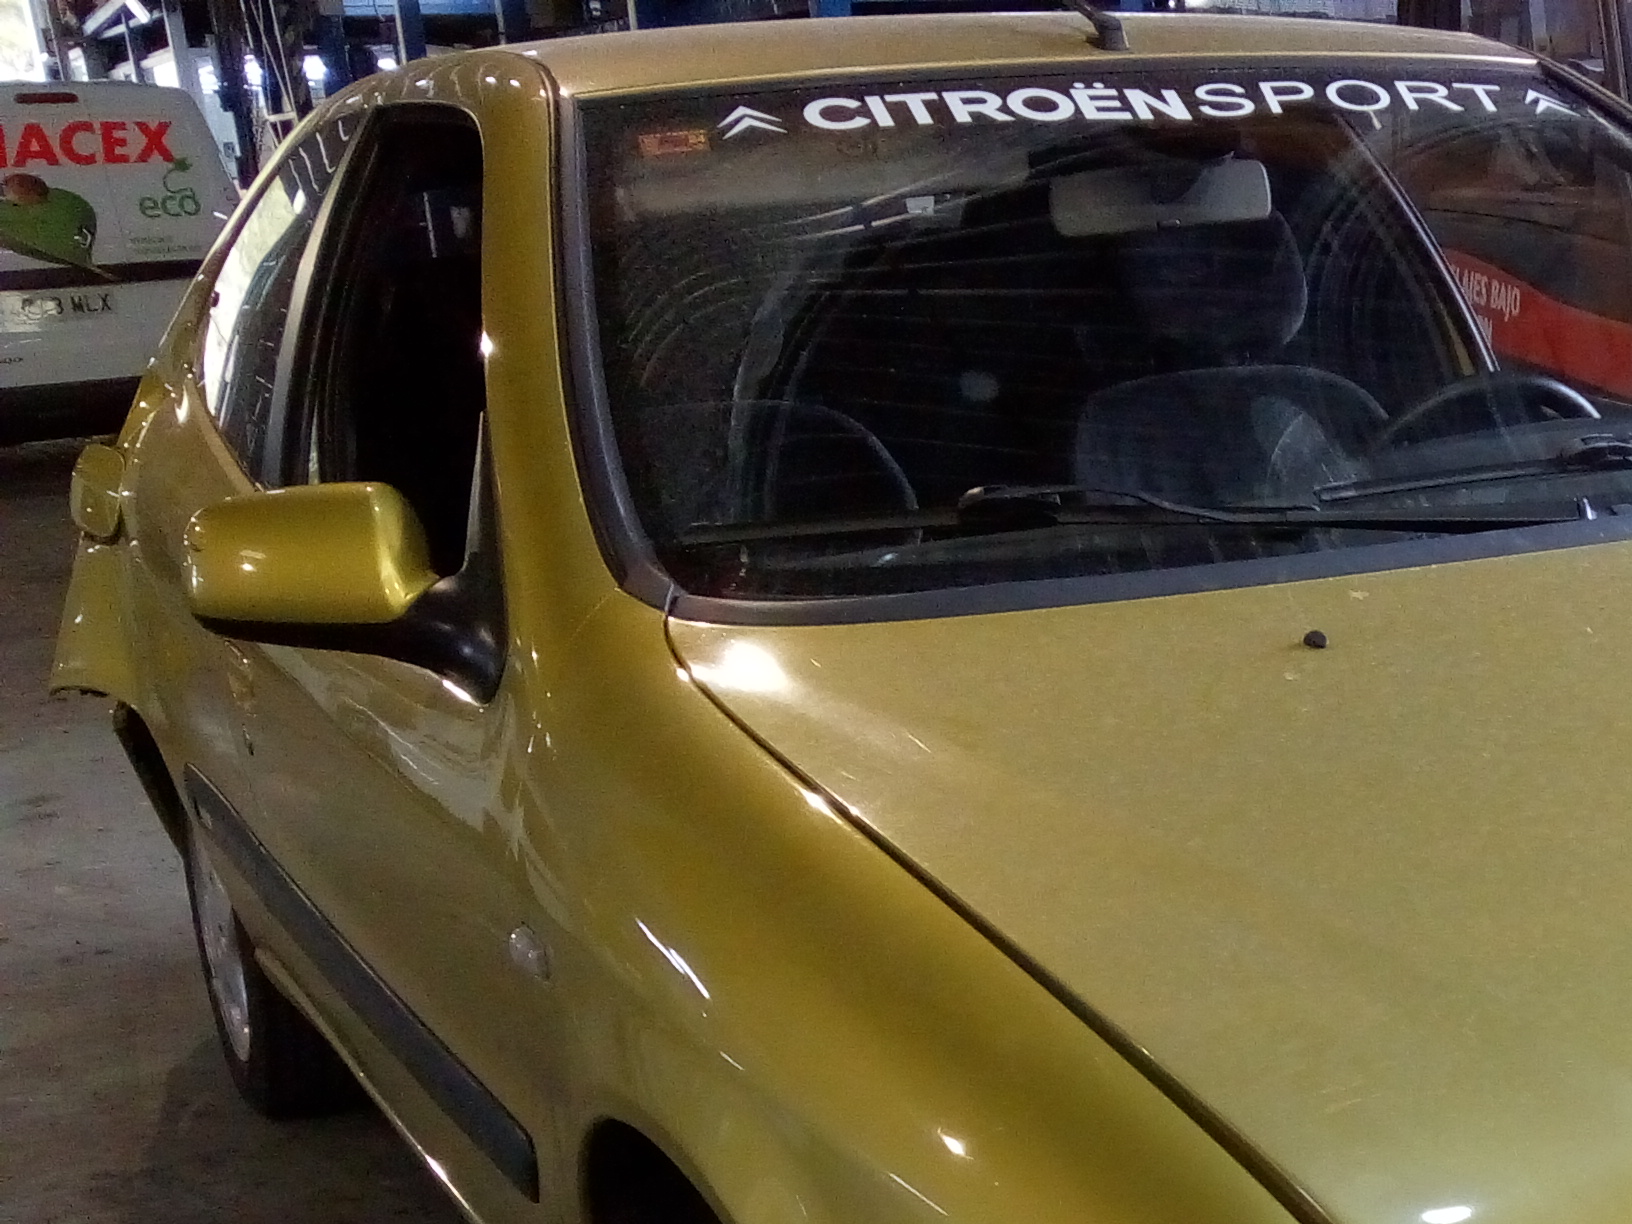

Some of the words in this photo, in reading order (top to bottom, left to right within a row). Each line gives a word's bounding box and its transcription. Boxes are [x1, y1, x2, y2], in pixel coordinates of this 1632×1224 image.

[0, 120, 175, 168] ACEX
[139, 190, 200, 218] eco
[1490, 279, 1520, 322] BAJO
